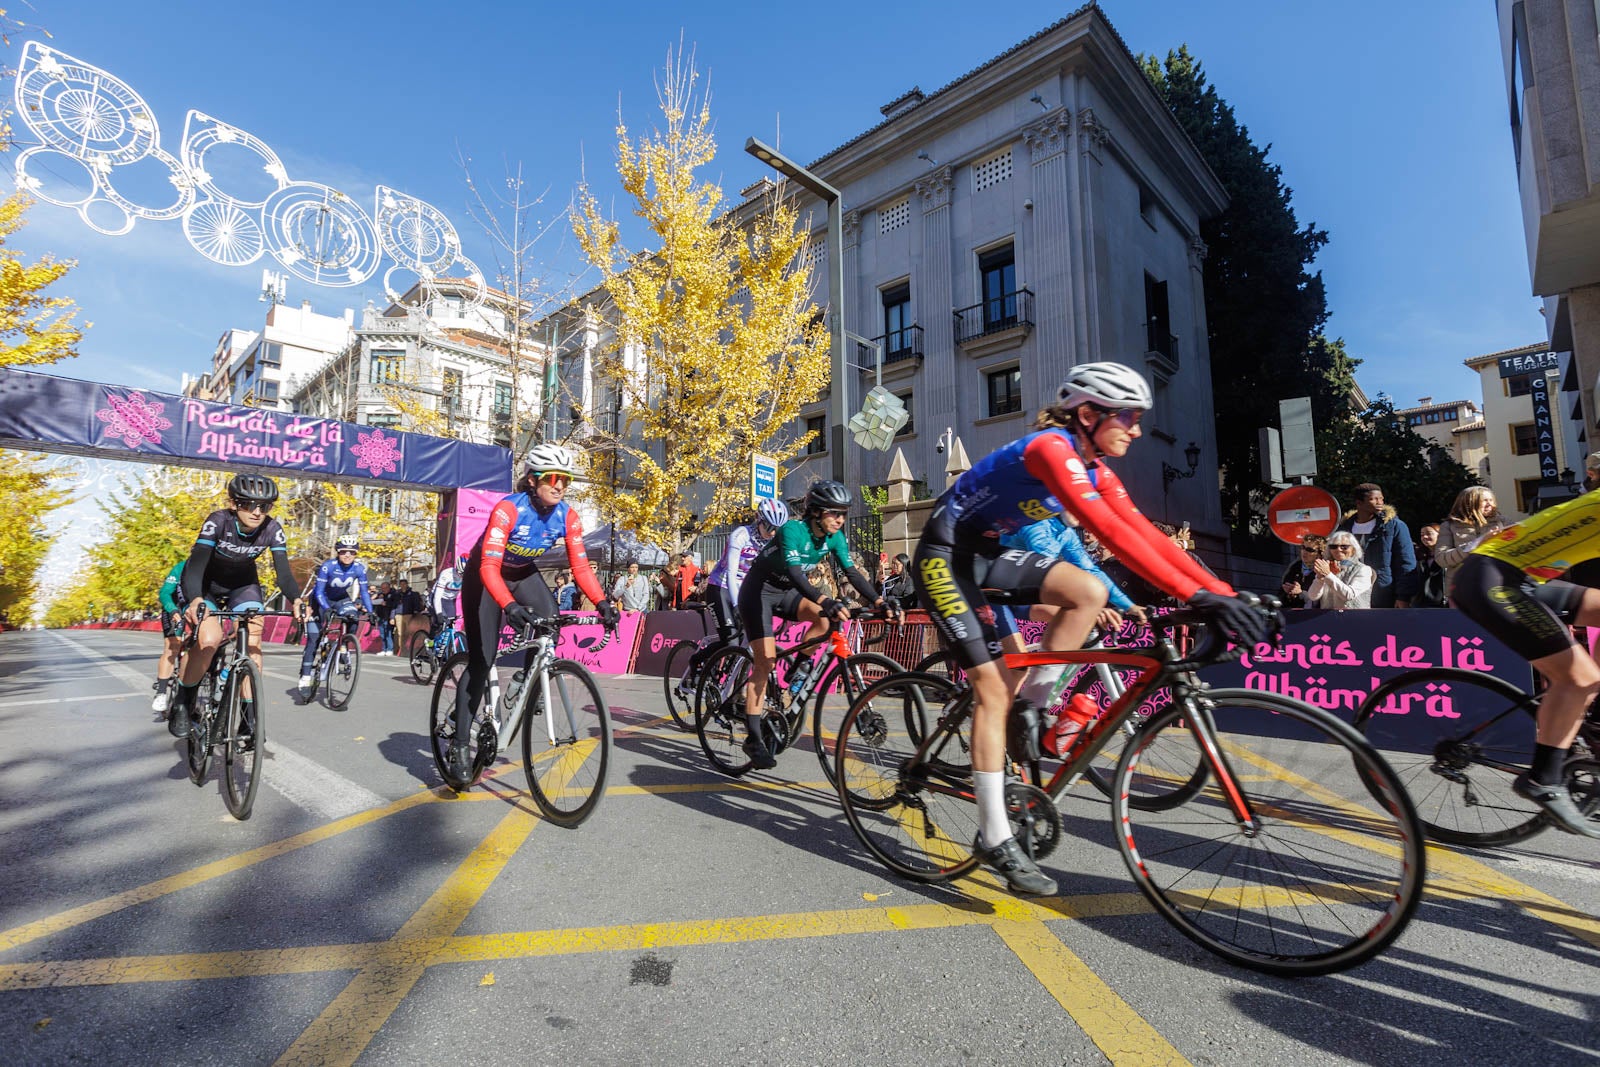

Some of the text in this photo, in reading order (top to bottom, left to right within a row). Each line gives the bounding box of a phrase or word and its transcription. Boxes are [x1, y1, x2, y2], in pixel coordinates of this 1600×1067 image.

[1502, 351, 1557, 368] TEATR
[285, 417, 318, 439] de
[1532, 378, 1555, 465] GRANADA
[759, 483, 773, 494] TAXI
[920, 557, 969, 619] SEMAR
[1372, 634, 1433, 669] de
